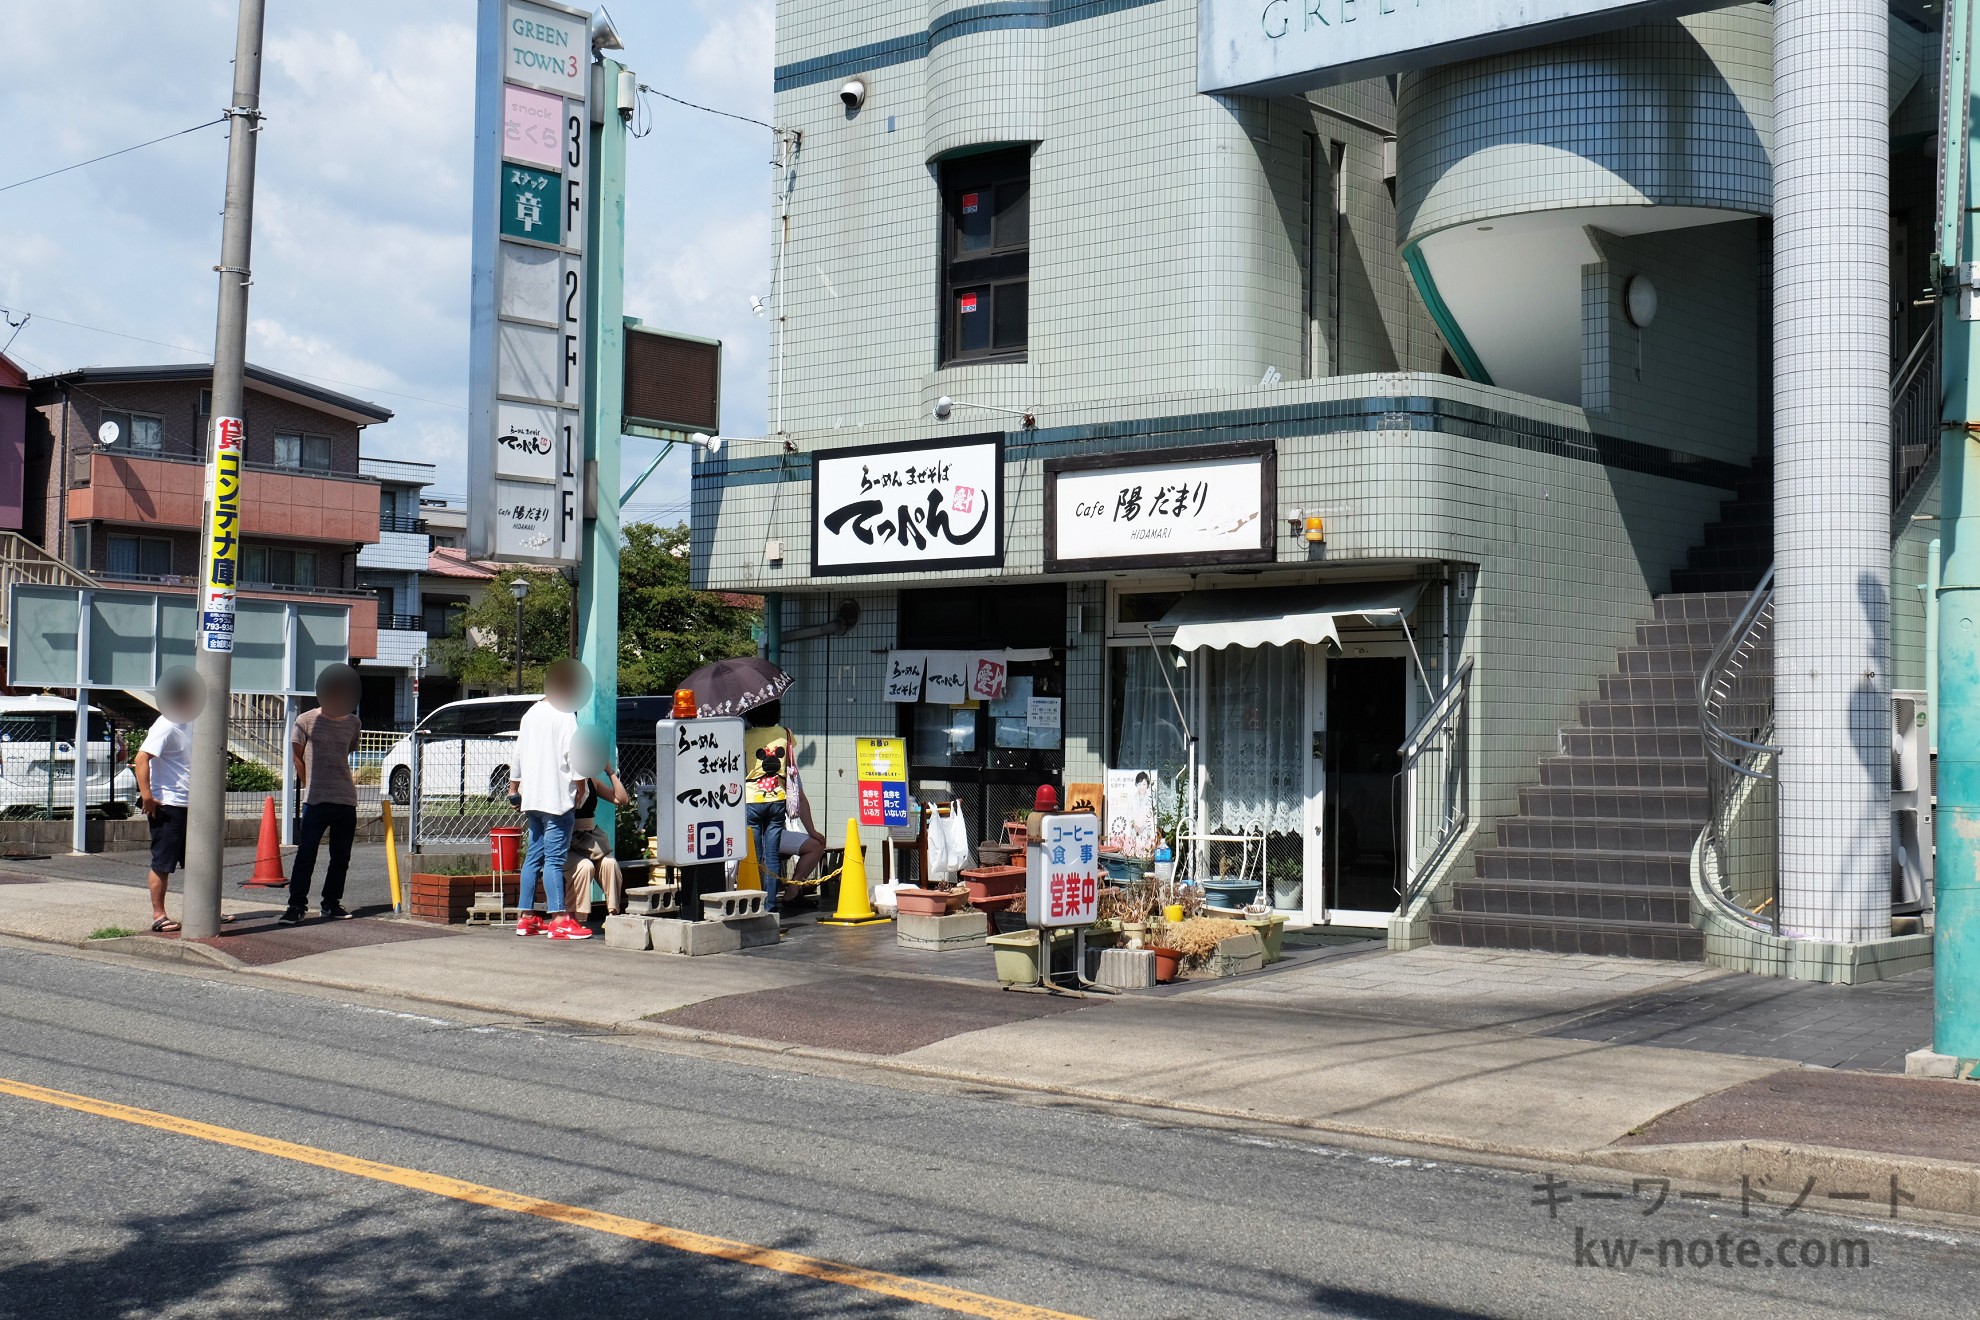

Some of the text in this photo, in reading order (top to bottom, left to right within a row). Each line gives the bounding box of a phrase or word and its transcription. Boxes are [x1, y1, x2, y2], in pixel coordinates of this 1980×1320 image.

[1262, 0, 1420, 40] GRE
[512, 18, 569, 49] GREEN
[511, 103, 552, 120] snack
[505, 120, 558, 149] さくら
[511, 170, 548, 191] スナック
[515, 192, 543, 232] 章
[498, 435, 552, 455] てっぺん
[860, 460, 953, 495] らーめん まぜそば
[1075, 480, 1208, 522] Cafe 陽だまり
[512, 505, 549, 522] 陽だまり
[824, 488, 989, 551] てっぺん
[1130, 528, 1173, 540] HIDAMARI
[892, 661, 920, 679] らーめん
[928, 673, 966, 687] てっぺん
[678, 725, 719, 756] らーめん
[698, 750, 741, 775] まぜそば
[676, 784, 743, 809] てっぺん
[862, 790, 879, 798] 食券を
[863, 799, 878, 807] 買って
[883, 791, 900, 799] 食券を
[884, 800, 899, 808] 買って
[864, 809, 880, 817] いる方
[884, 809, 907, 818] いない方
[1053, 824, 1094, 843] コーヒー
[726, 837, 733, 857] 有り
[1050, 871, 1095, 918] 営業中
